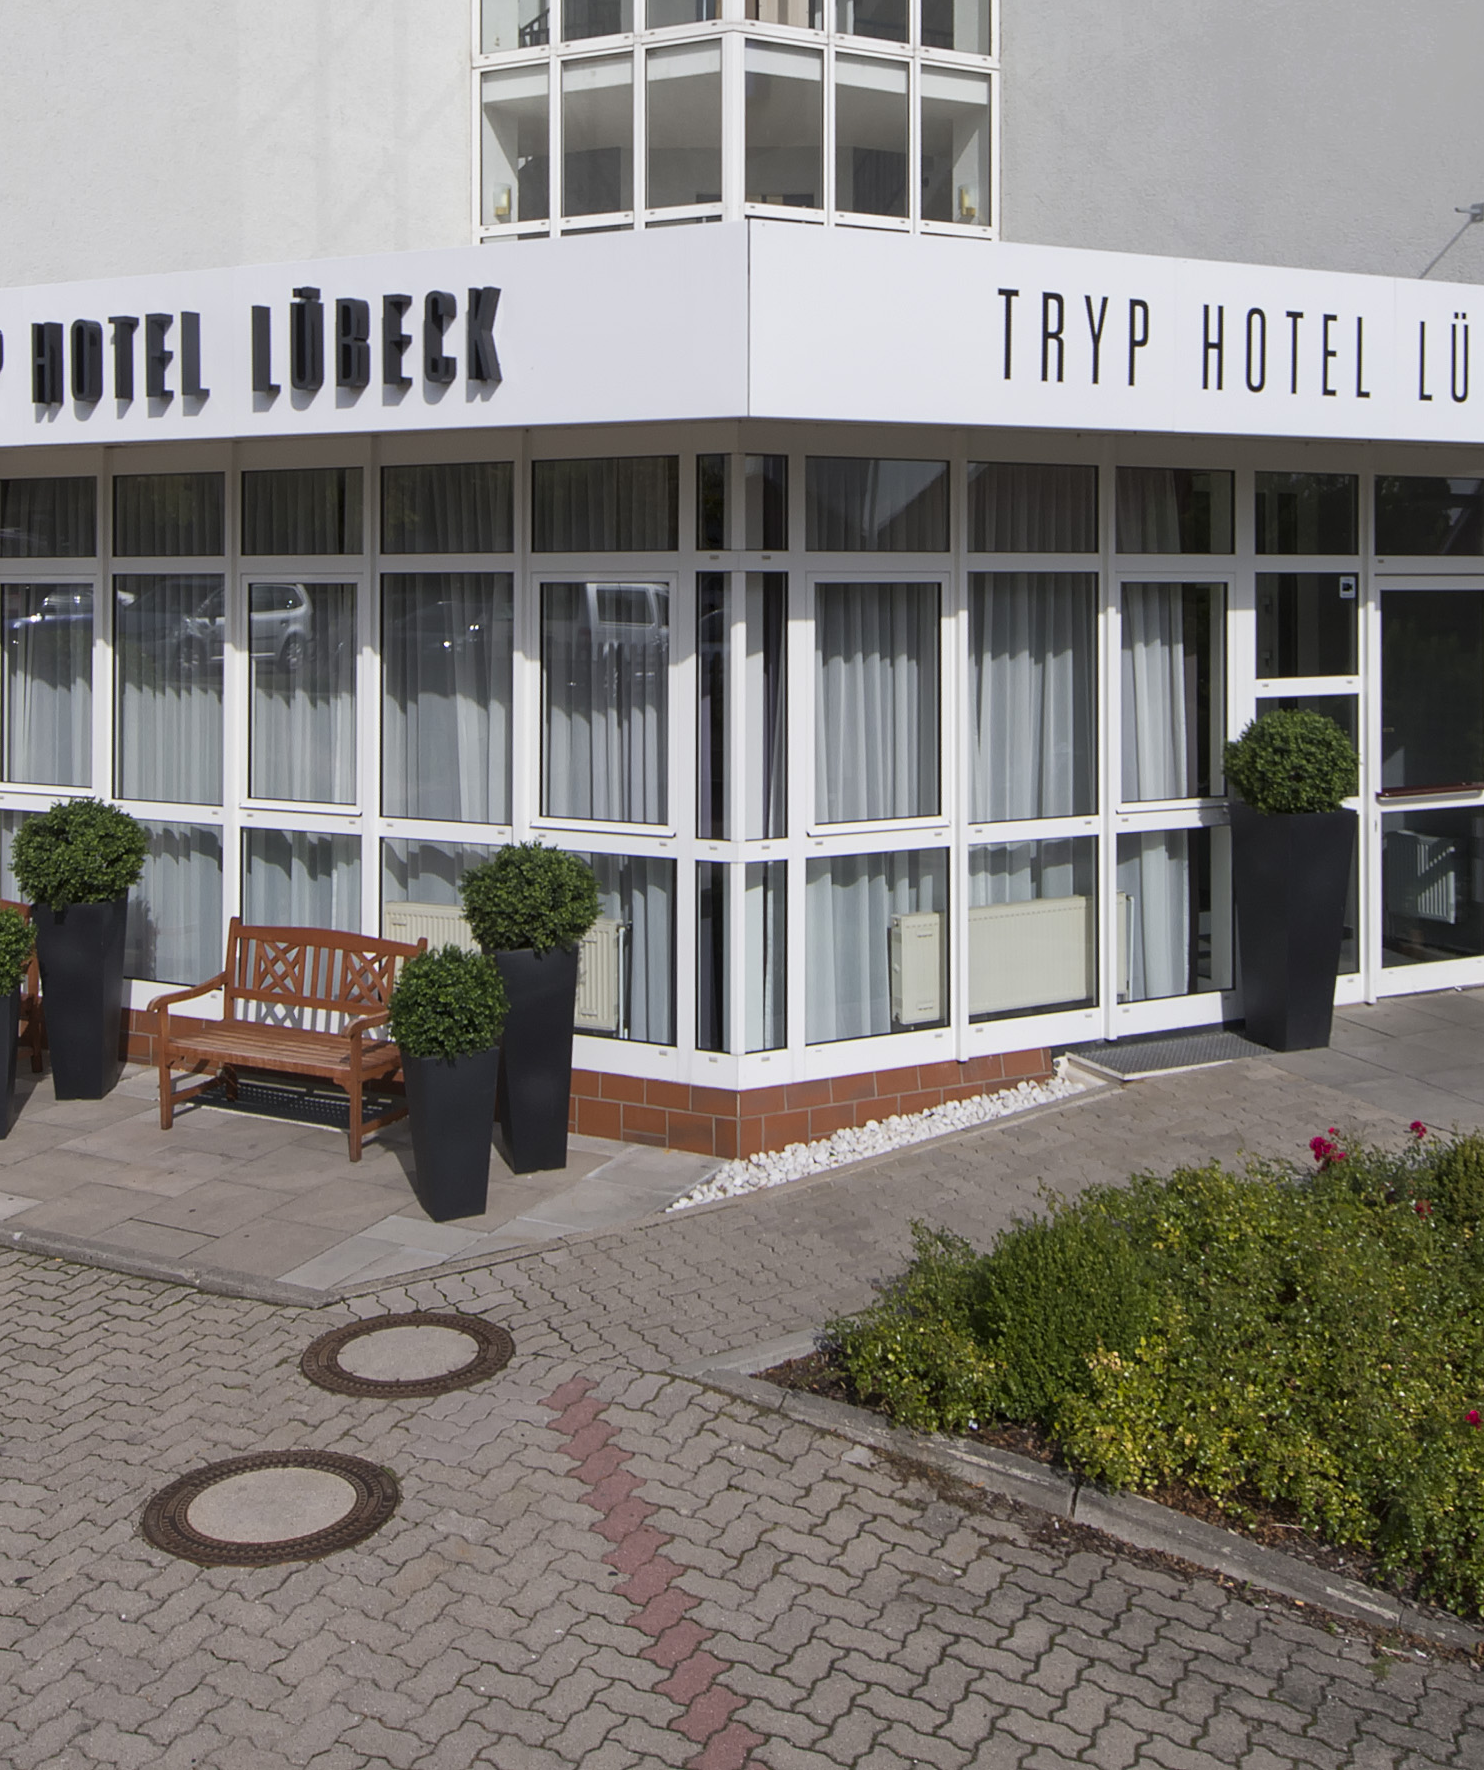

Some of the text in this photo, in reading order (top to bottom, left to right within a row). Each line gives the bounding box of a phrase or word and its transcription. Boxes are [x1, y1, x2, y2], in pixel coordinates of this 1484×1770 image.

[31, 311, 209, 404] HOTEL
[252, 286, 501, 392] LÜBECK
[998, 288, 1150, 386] TRYP
[1202, 304, 1371, 400] HOTEL
